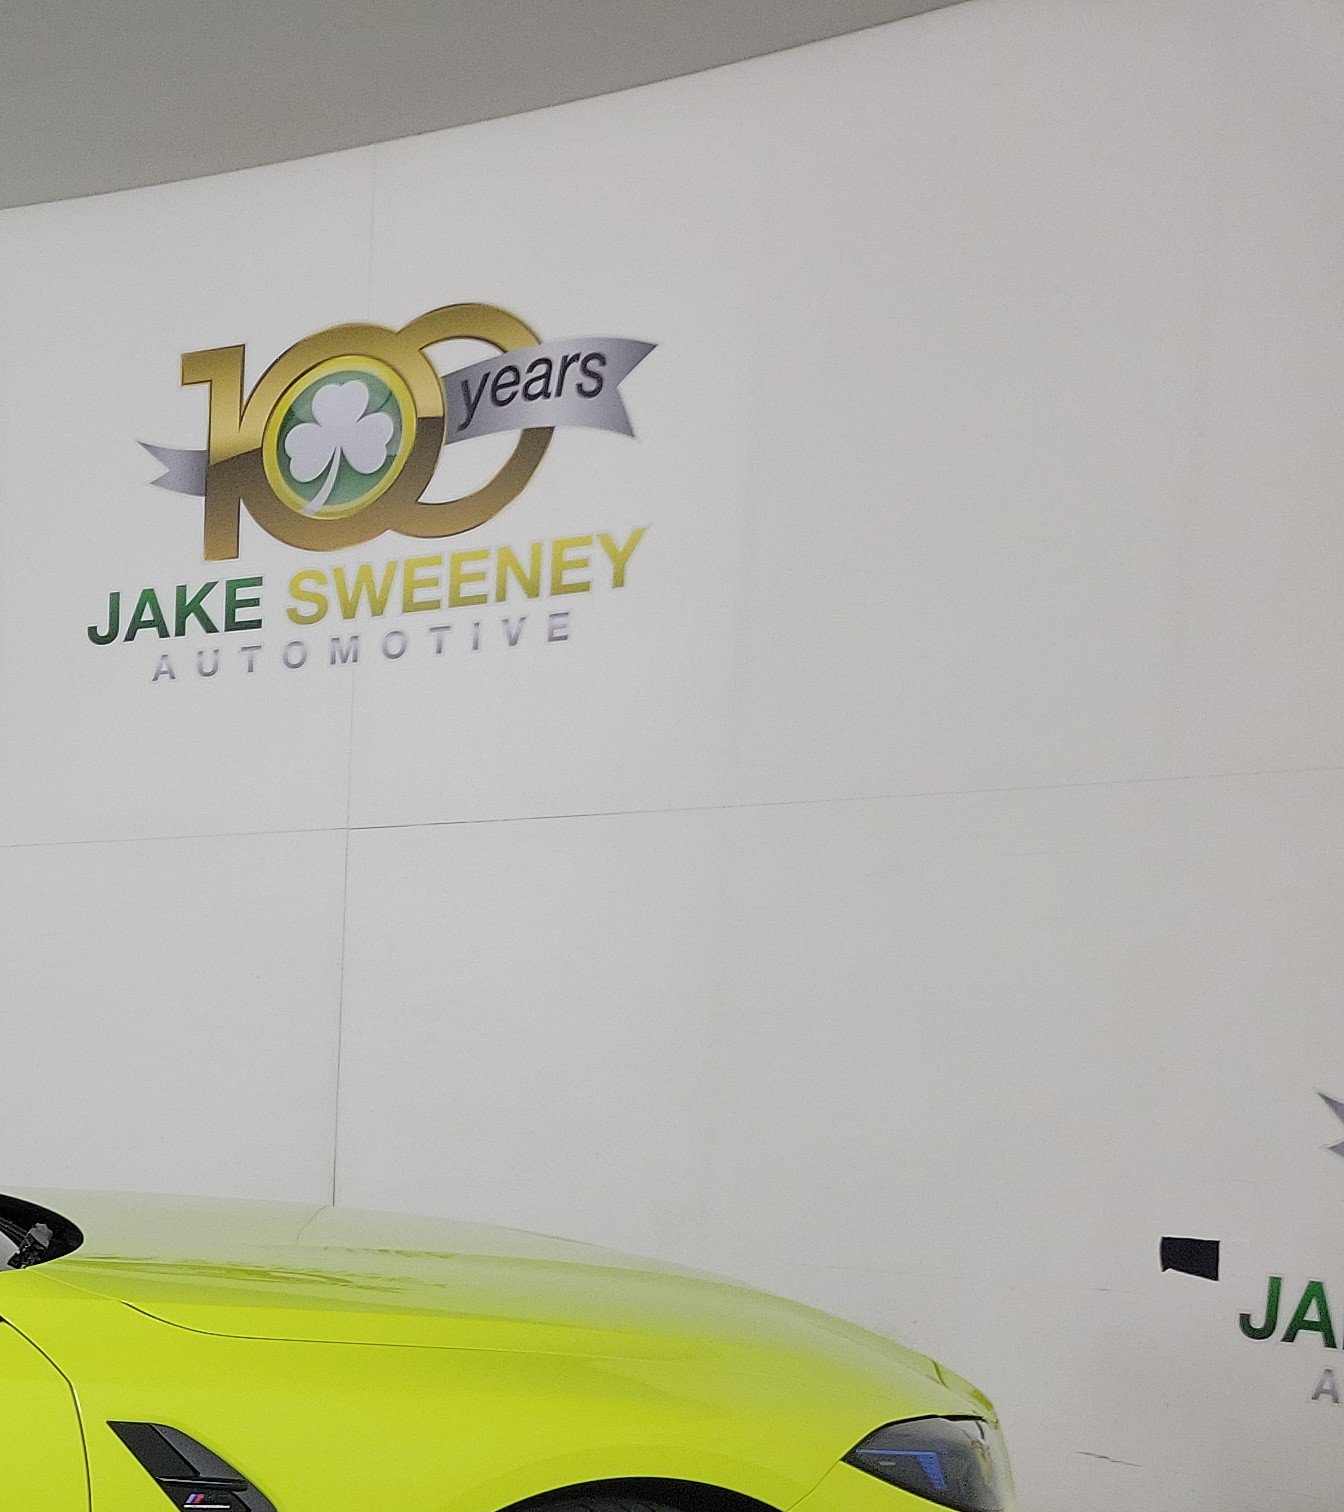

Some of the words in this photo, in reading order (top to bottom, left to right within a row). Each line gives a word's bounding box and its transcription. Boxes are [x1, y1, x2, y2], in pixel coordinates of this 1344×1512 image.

[181, 302, 555, 561] 100
[457, 348, 606, 428] years
[87, 576, 264, 645] JAKE
[285, 527, 649, 625] SWEENEY
[152, 612, 570, 681] AUTOMOTIVE
[1239, 1275, 1344, 1349] JA
